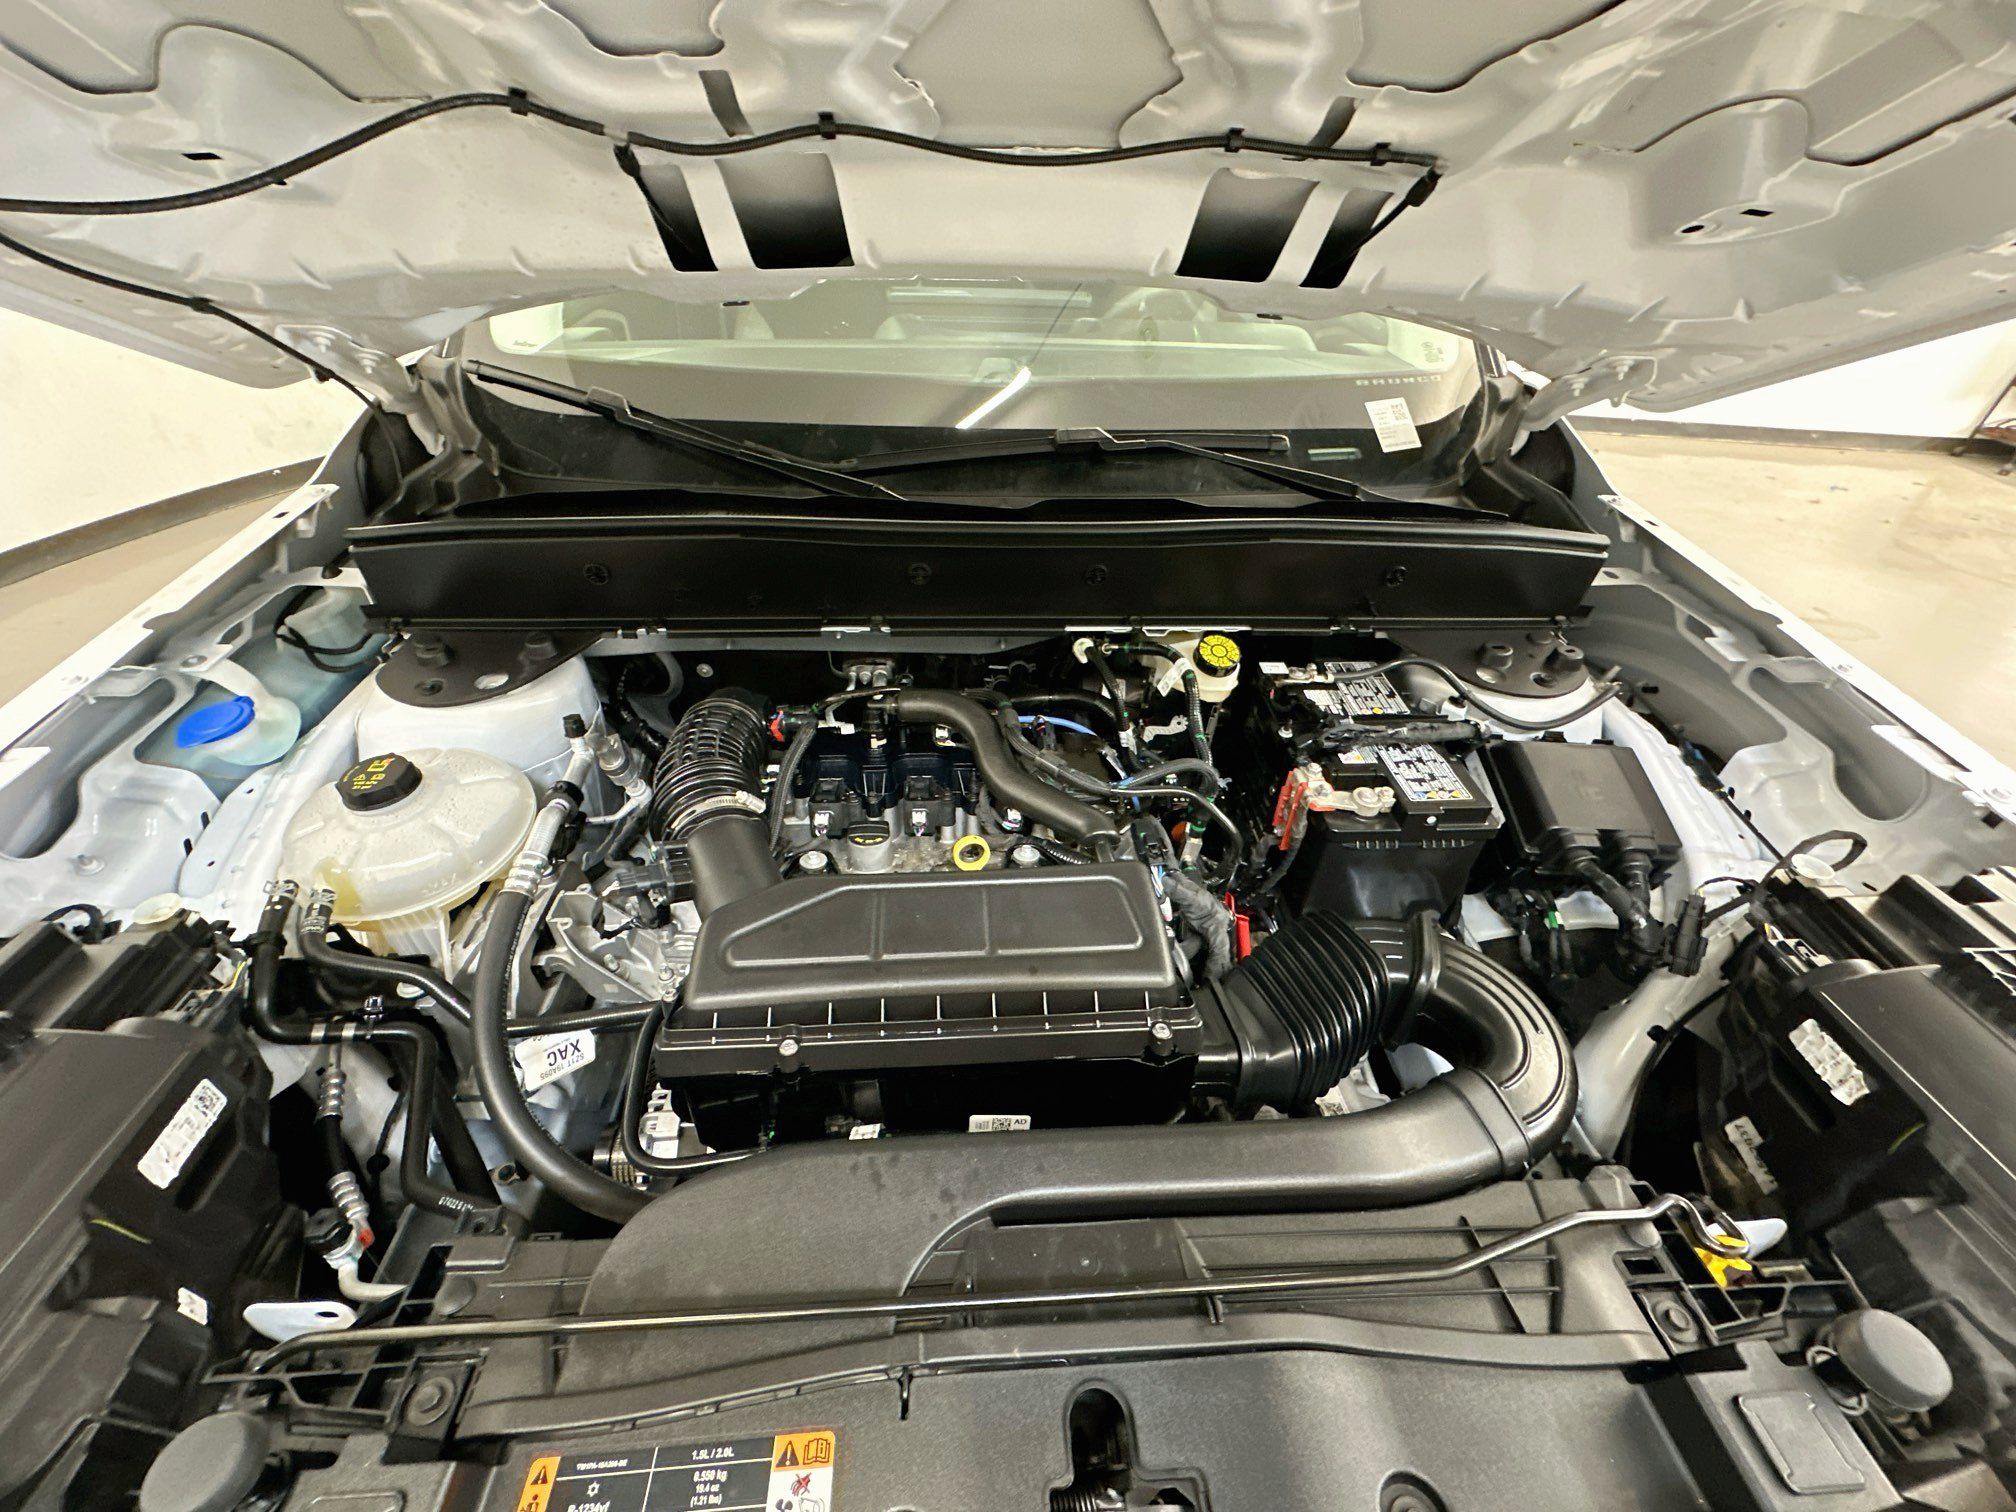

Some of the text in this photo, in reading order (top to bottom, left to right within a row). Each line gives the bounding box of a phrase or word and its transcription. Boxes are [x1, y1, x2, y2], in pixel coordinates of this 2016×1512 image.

[547, 1039, 581, 1067] XAC
[715, 1446, 735, 1458] 2.0L
[716, 1469, 728, 1482] kg
